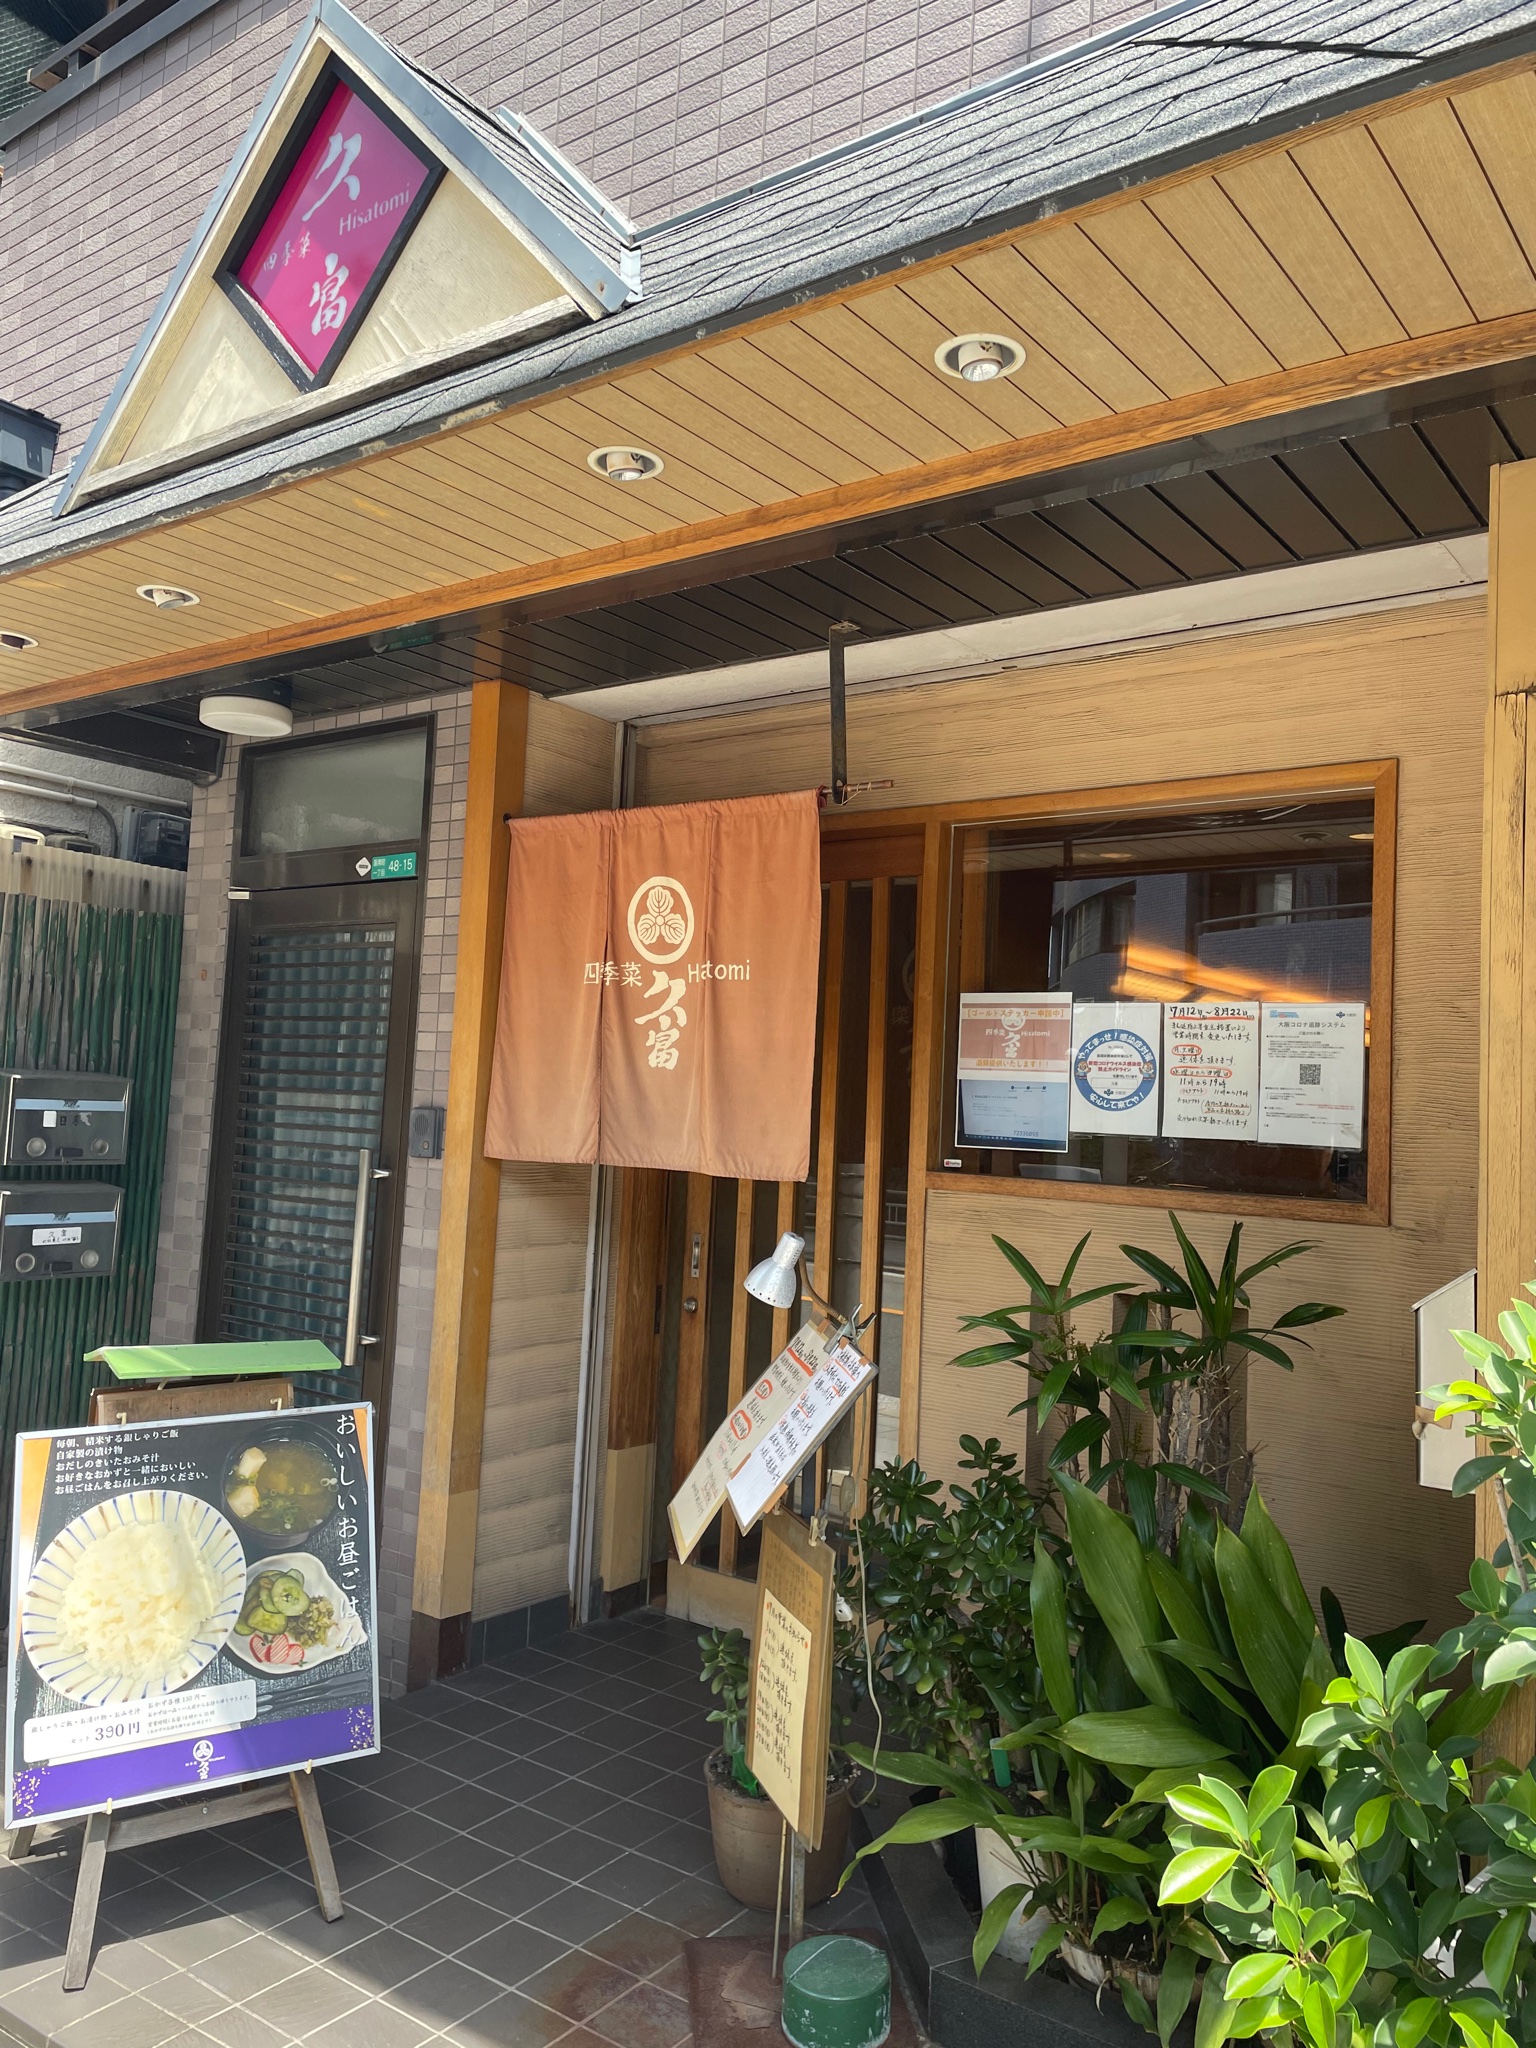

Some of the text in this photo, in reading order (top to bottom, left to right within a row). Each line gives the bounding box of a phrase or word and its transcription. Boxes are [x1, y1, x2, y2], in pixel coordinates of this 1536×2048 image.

[339, 183, 411, 236] Hisatomi
[301, 131, 362, 336] 久富
[263, 231, 311, 271] 四季菜
[388, 858, 413, 872] 48-15
[584, 960, 643, 987] 四季菜
[634, 969, 688, 1070] 久富
[56, 1428, 179, 1449] 毎朝、精米する銀しゃりご飯
[55, 1453, 160, 1471] おだしのきいたおみそ汁
[56, 1446, 123, 1460] 自家製の漬け物
[54, 1471, 209, 1495] お昼ごはんをお召し上がりください。
[55, 1462, 196, 1483] お好きなおかずと一緒においしい
[336, 1414, 360, 1648] おいしいお昼ごはん
[95, 1721, 140, 1741] 390円
